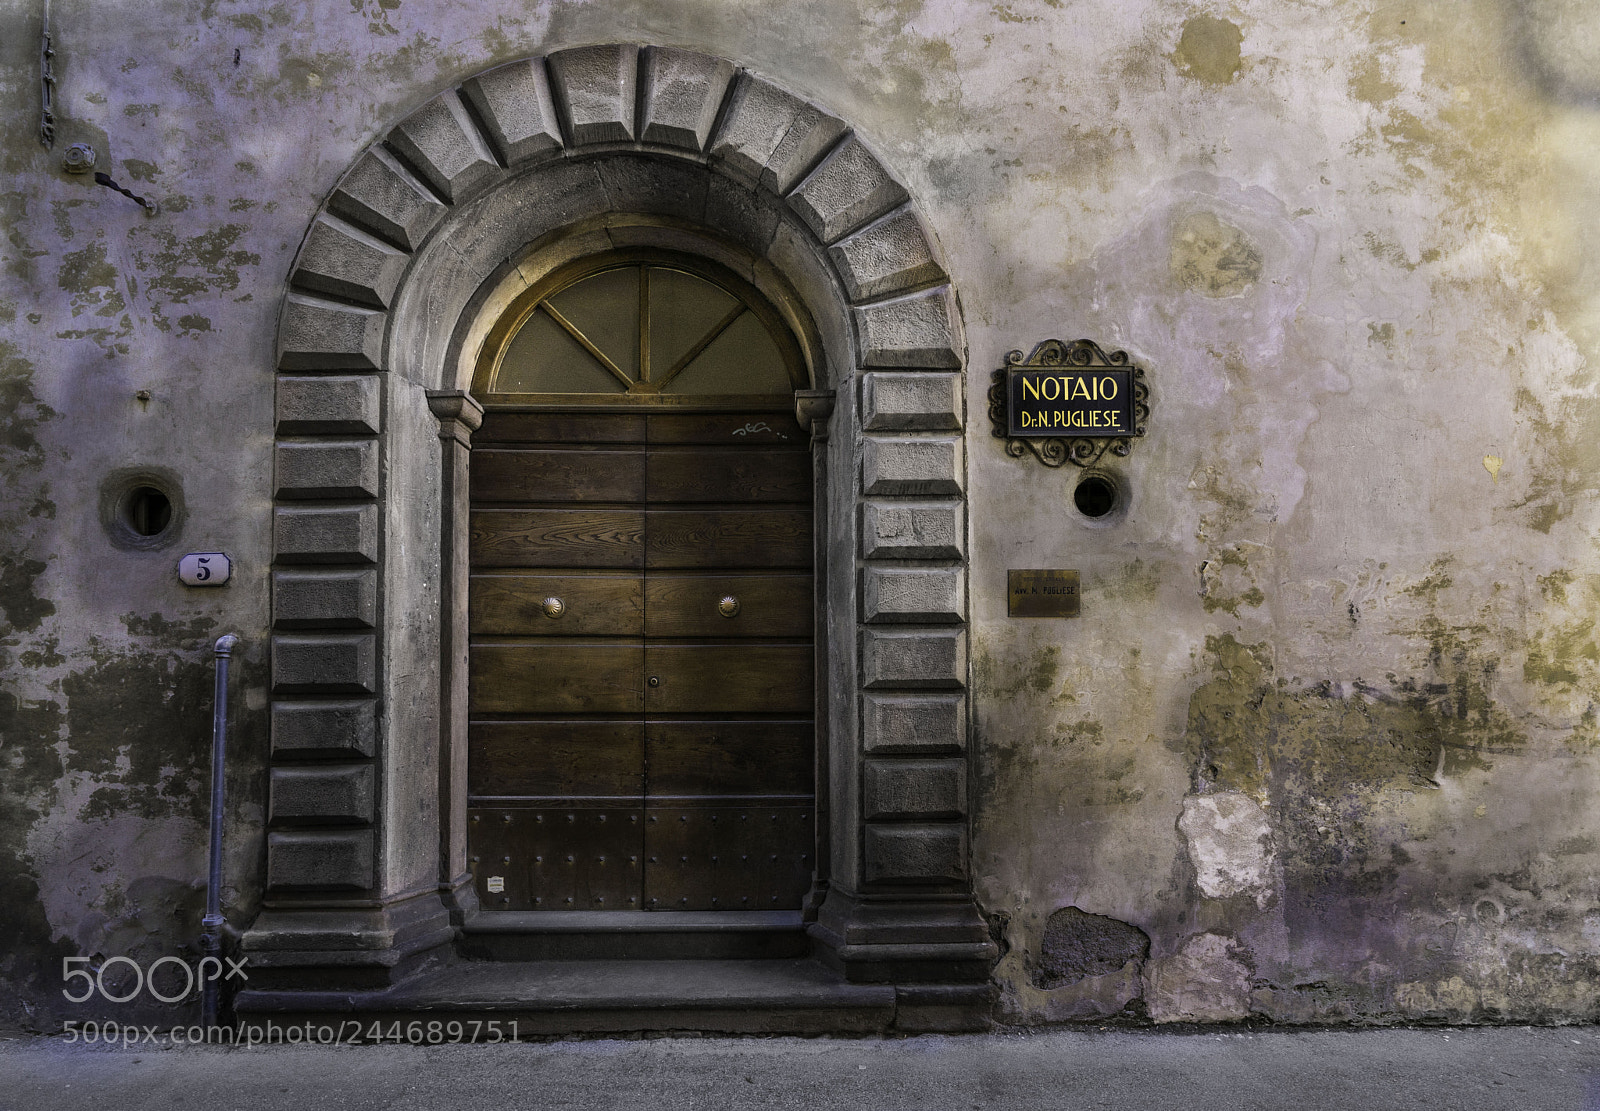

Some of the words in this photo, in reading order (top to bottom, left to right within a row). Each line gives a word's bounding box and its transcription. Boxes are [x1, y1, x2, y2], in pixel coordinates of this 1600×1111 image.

[1022, 376, 1118, 401] NOTAIO
[1054, 410, 1121, 428] PUGLIESE
[196, 557, 211, 581] 5
